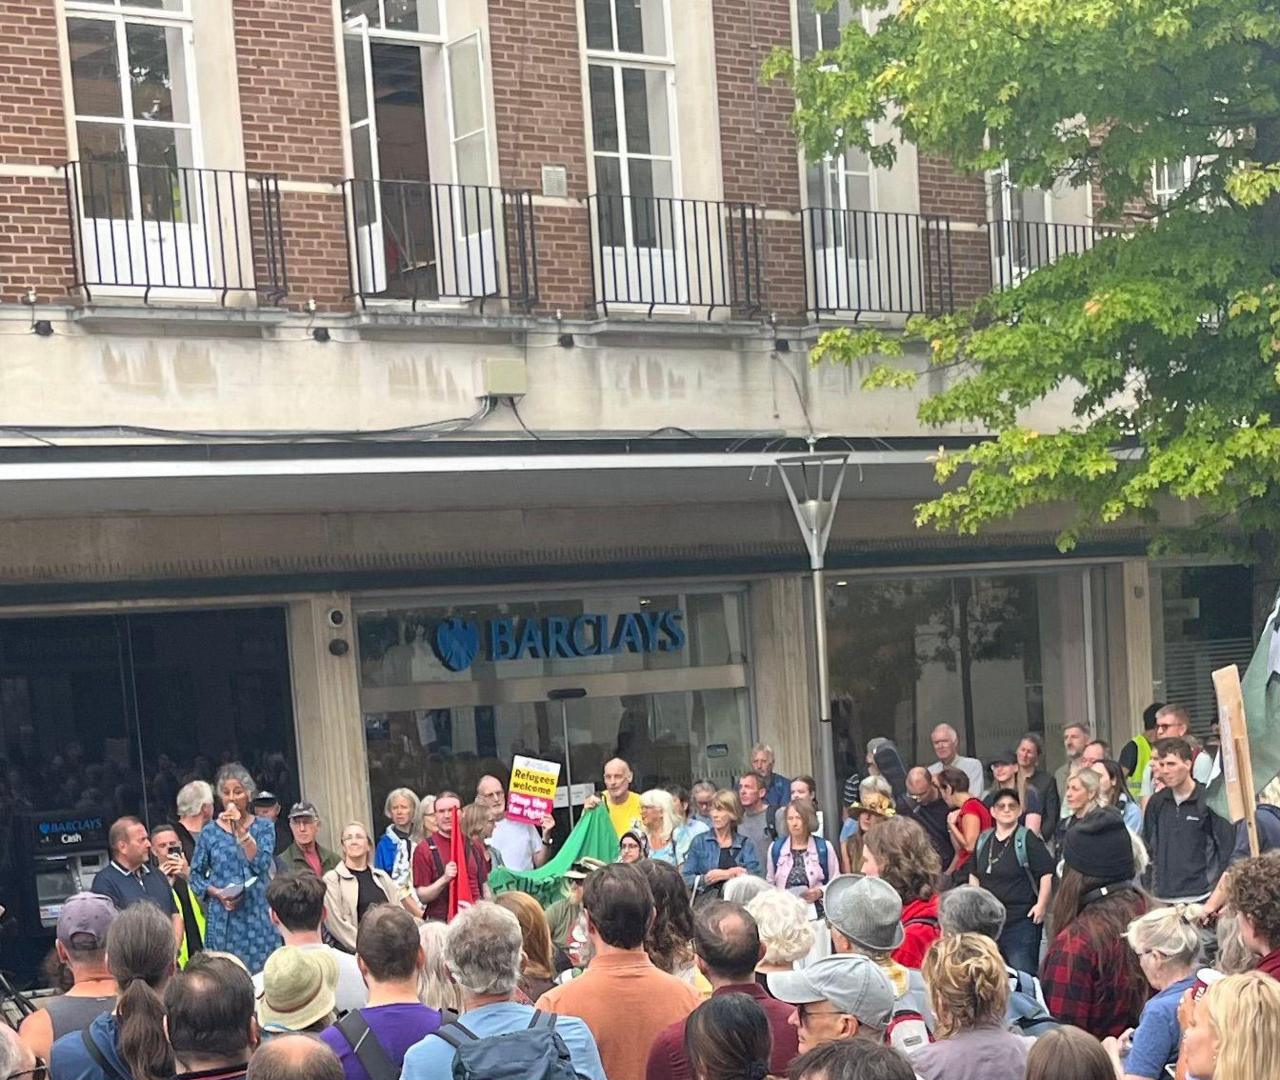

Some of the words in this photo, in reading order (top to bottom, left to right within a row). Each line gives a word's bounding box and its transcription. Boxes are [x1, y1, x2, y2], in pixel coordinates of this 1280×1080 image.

[487, 608, 687, 662] BARCLAYS
[514, 768, 556, 786] Refugees
[512, 781, 552, 796] welcome
[510, 793, 531, 807] Stop
[532, 797, 548, 809] the
[508, 803, 523, 815] far
[51, 818, 103, 833] BARCLAYS
[61, 833, 83, 844] Cash
